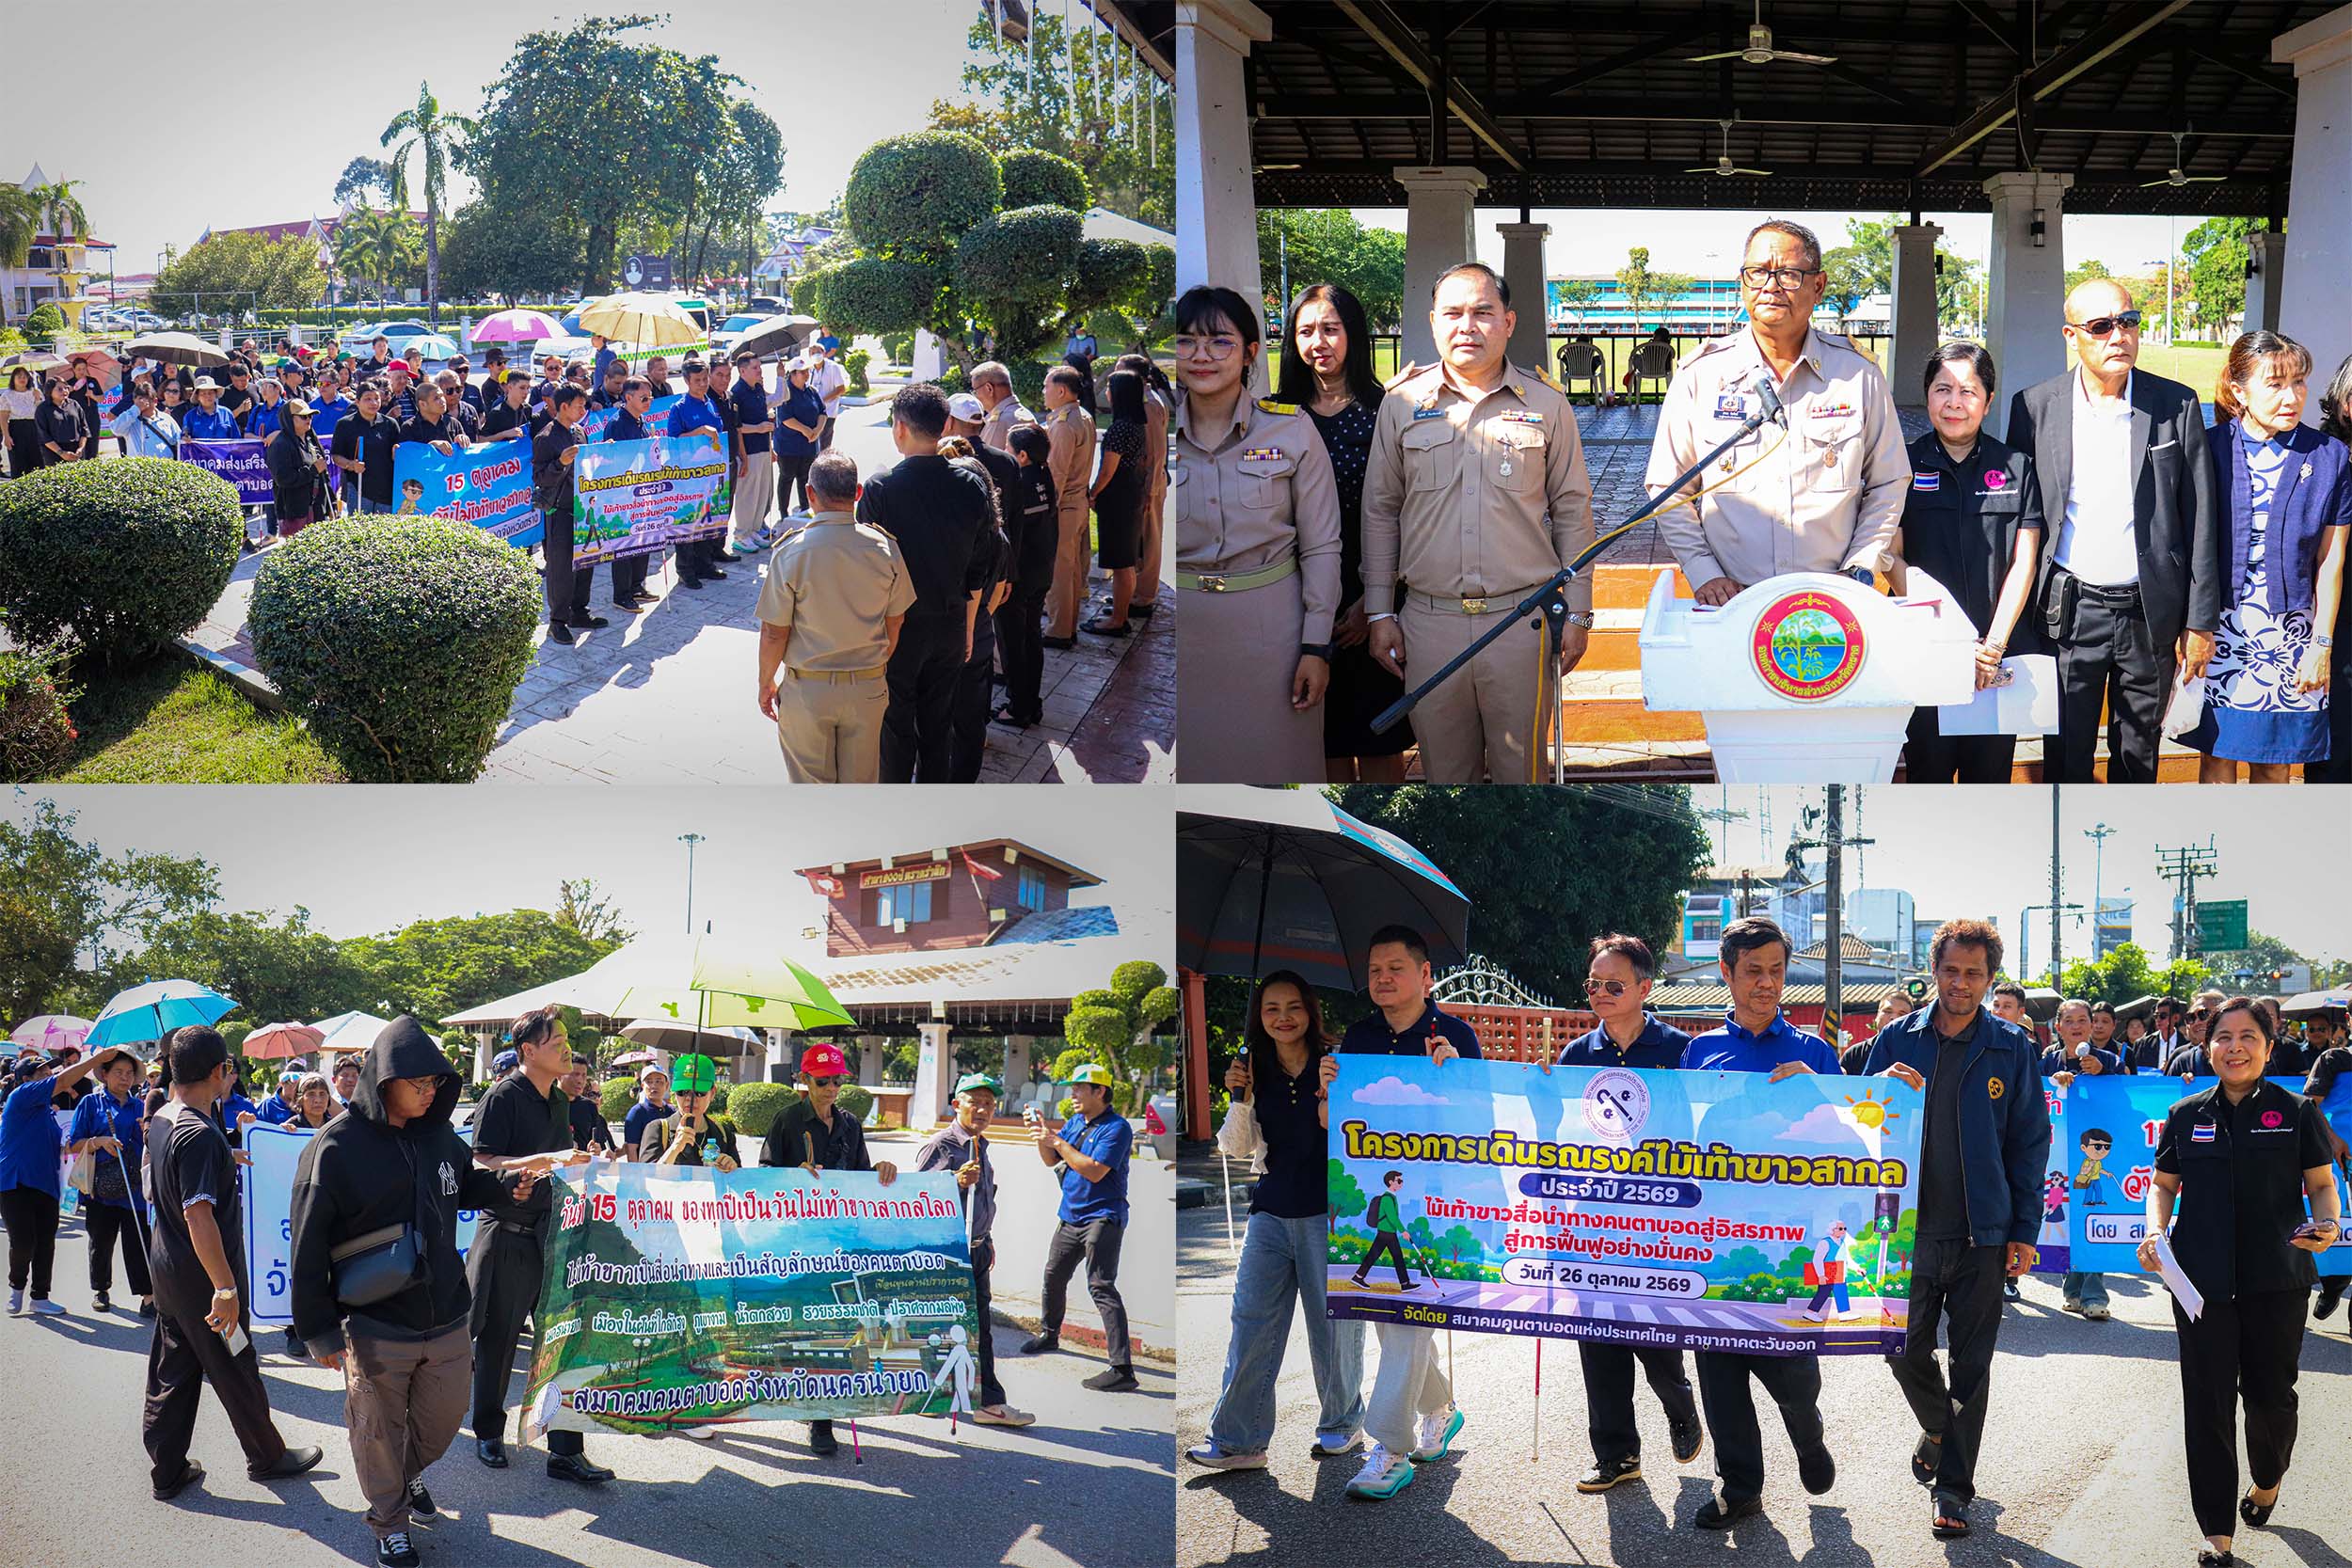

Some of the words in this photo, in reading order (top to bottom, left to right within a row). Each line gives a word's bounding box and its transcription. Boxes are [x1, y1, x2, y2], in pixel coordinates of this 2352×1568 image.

[446, 473, 465, 491] 15
[471, 458, 521, 491] ตุลาคม
[1343, 1121, 1906, 1188] โครงการเดินรณรงค์ไม้เท้าขาวสากล
[560, 1184, 588, 1231] วันที่
[592, 1194, 617, 1222] 15
[628, 1199, 674, 1230] ตุลาคม
[682, 1187, 958, 1230] ของทุกปีเป็นวันไม้เท้าขาวสากลโลก
[1541, 1177, 1619, 1200] ประจำปี
[1623, 1184, 1679, 1203] 2569
[1423, 1196, 1806, 1243] ไม้เท้าขาวสื่อนำทางคนตาบอดสู่อิสรภาพ
[2092, 1219, 2117, 1239] โดย
[1503, 1227, 1713, 1262] สู่การฟื้นฟูอย่างมั่นคง
[1519, 1262, 1554, 1282] วันที่
[1560, 1267, 1582, 1283] 26
[1587, 1273, 1641, 1291] ตุลาคม
[1646, 1275, 1691, 1292] 2569
[693, 1311, 728, 1336] ภูเขางาม
[735, 1302, 792, 1325] น้ำตกสวย
[802, 1299, 881, 1321] รวยธรรมชาติ
[888, 1296, 966, 1319] ปราศจากมลพิษ
[1403, 1305, 1447, 1324] จัดโดย
[1452, 1312, 1677, 1343] สมาคมคนตาบอดแห่งประเทศไทย
[1683, 1333, 1817, 1352] สาขาภาคตะวันออก
[572, 1369, 930, 1415] สมาคมคนตาบอดจังหวัดนครนายก
